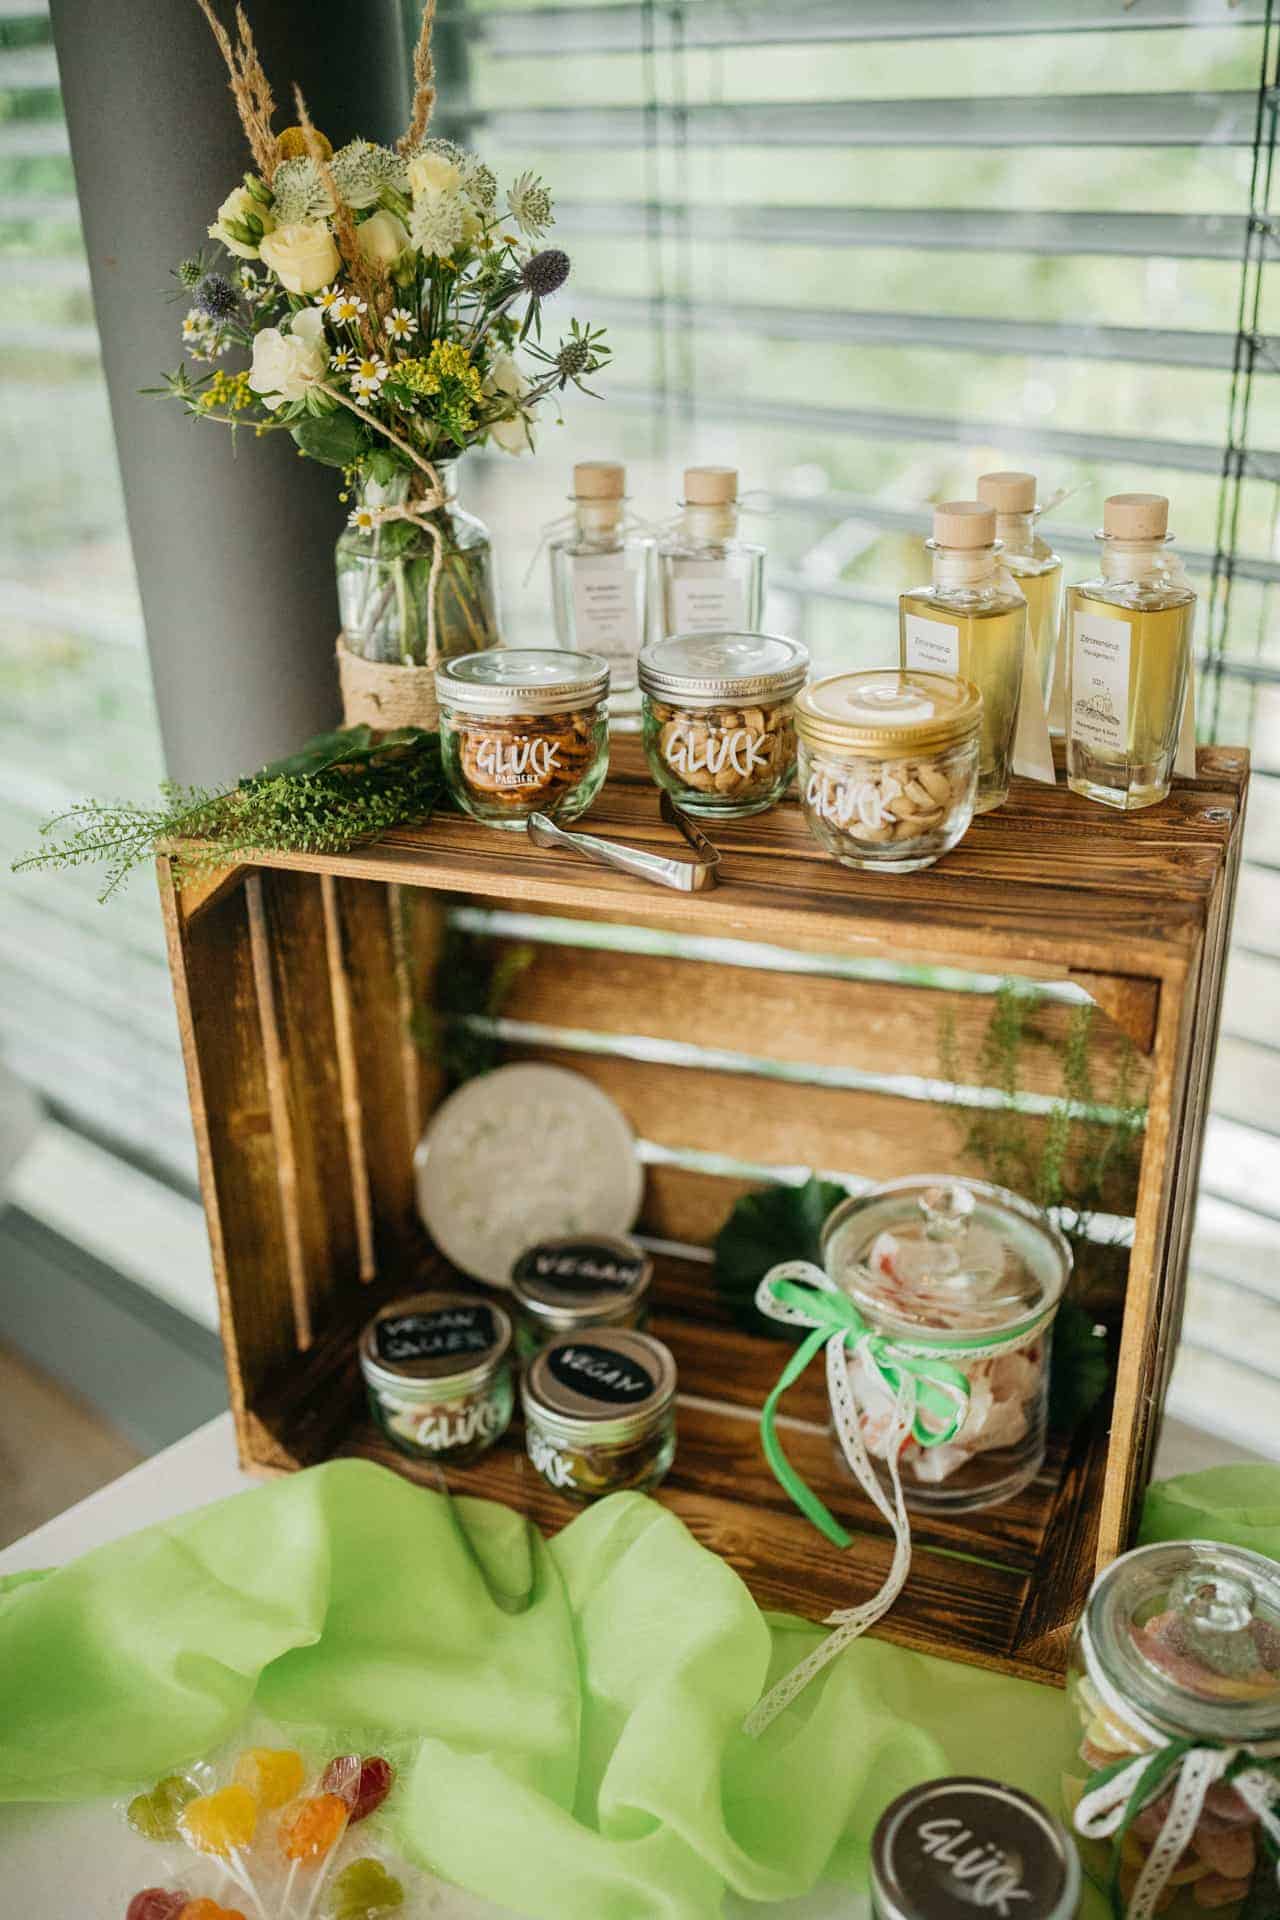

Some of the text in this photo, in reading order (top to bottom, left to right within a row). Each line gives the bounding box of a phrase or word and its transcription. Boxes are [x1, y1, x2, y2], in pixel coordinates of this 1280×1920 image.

[475, 735, 562, 776] GLÜCK
[665, 727, 769, 777] GLÜCK
[536, 1254, 640, 1284] VEGAN
[560, 1350, 645, 1392] VEGAN
[917, 1818, 1032, 1917] GLÜCK
